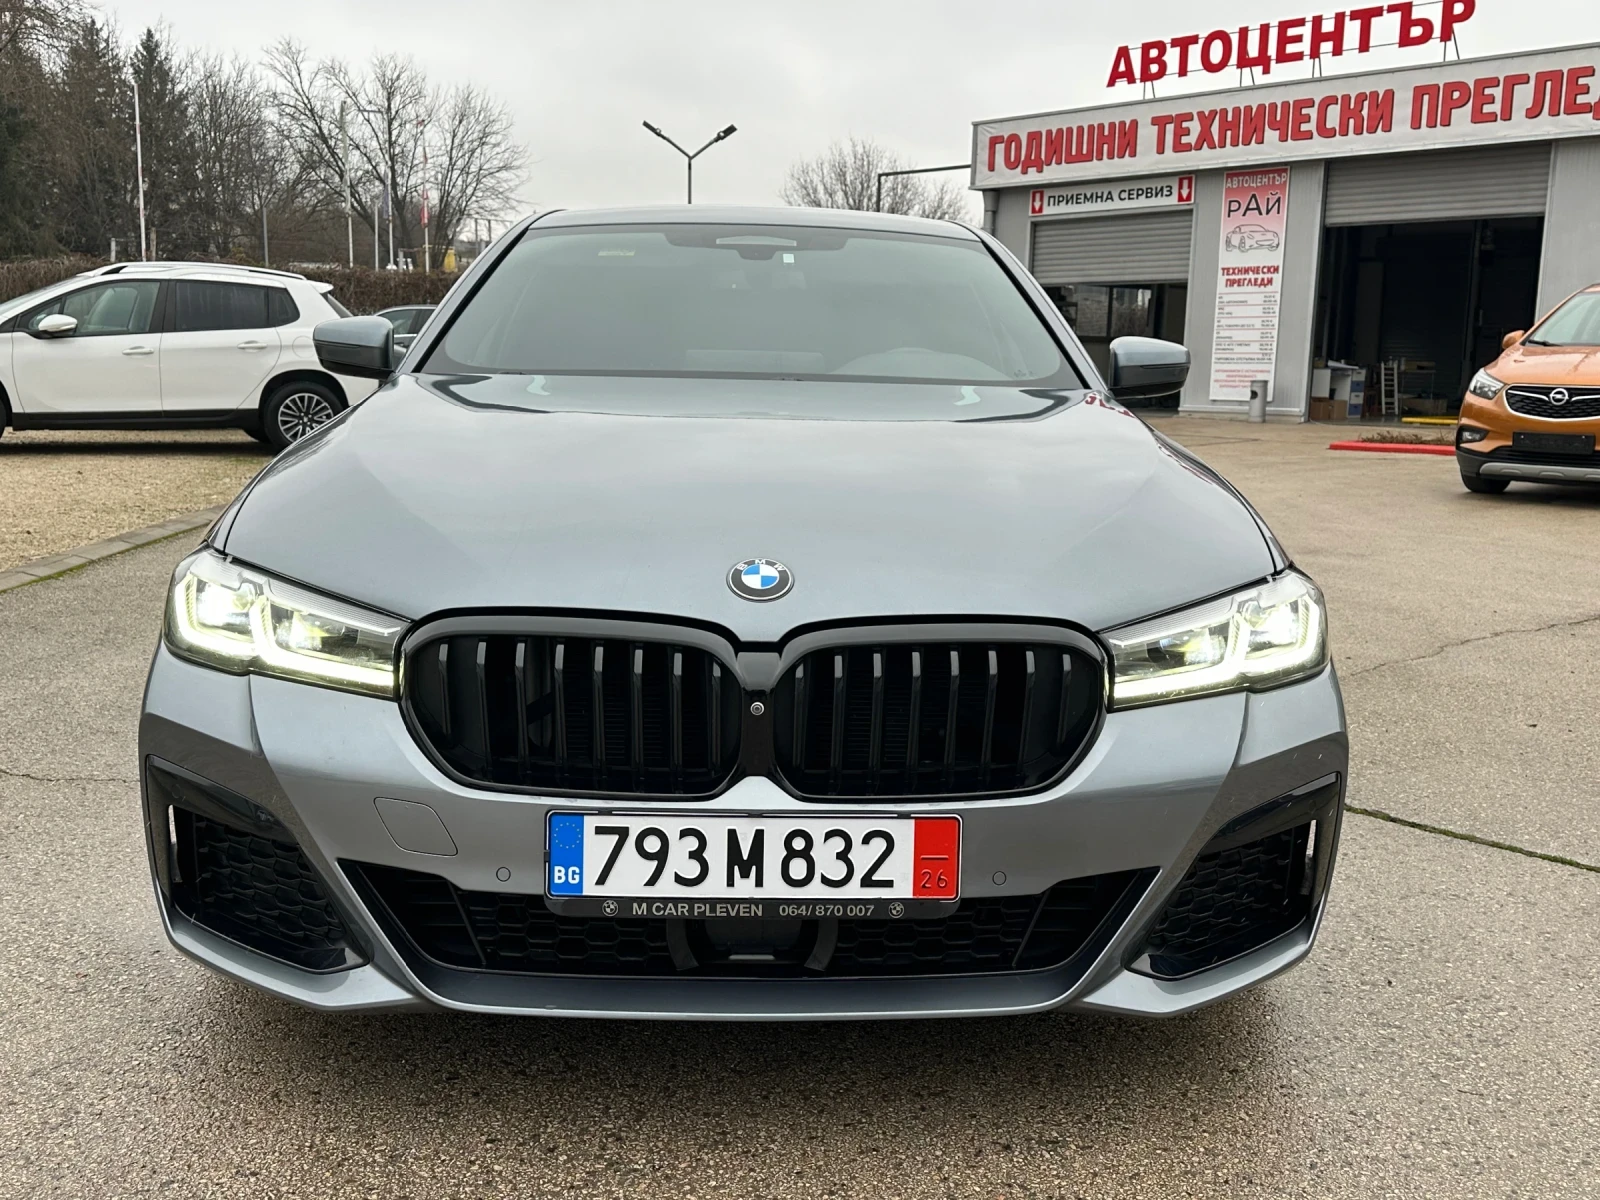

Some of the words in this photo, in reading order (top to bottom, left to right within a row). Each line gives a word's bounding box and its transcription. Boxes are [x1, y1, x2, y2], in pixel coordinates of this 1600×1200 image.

[1106, 0, 1476, 87] АВТОЦЕНТЪР
[988, 119, 1138, 174] ГОДИШНИ
[1151, 89, 1395, 154] ТЕХНИЧЕСКИ
[1410, 65, 1600, 129] ПРЕГЛЕ
[1226, 173, 1287, 188] АВТОЦЕНТЪР
[1047, 190, 1114, 207] ПРИЕМНА
[1118, 185, 1173, 201] СЕРВИЗ
[1221, 265, 1280, 276] ТЕХНИЧЕСКИ
[1225, 277, 1273, 288] ПРЕГЛЕДИ
[594, 825, 710, 887] 793
[726, 828, 765, 888] M
[780, 828, 896, 888] 832
[553, 866, 580, 884] BG
[920, 868, 948, 889] 26
[632, 902, 647, 915] M
[652, 903, 689, 916] CAR
[693, 903, 763, 917] PLEVEN
[846, 904, 875, 917] 007
